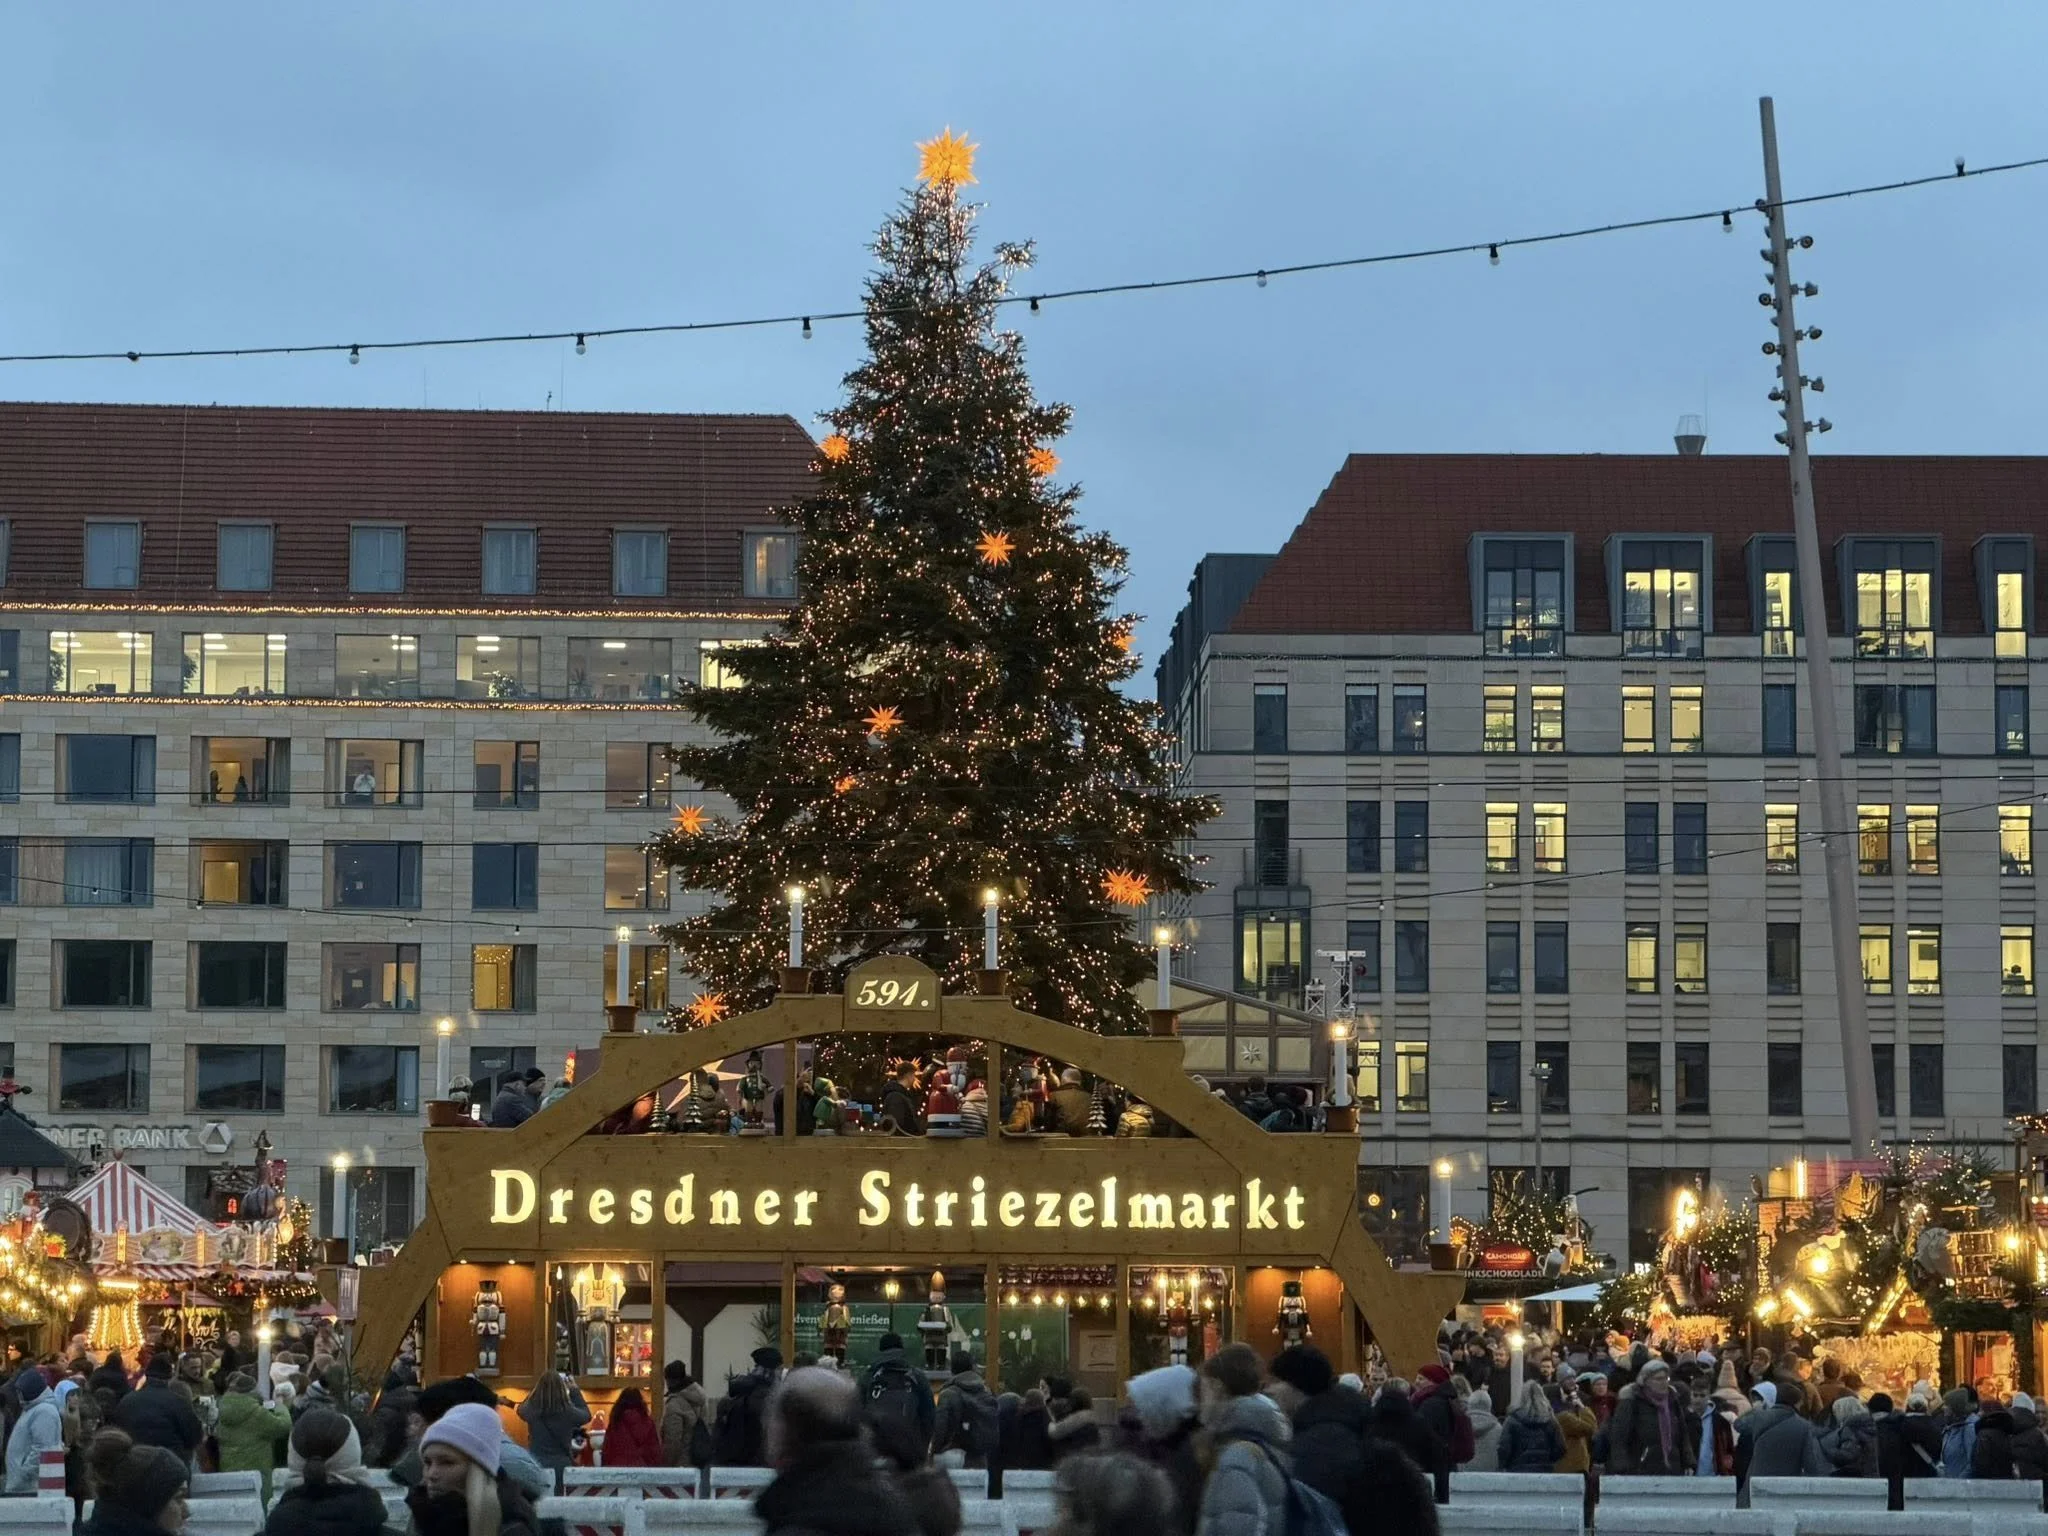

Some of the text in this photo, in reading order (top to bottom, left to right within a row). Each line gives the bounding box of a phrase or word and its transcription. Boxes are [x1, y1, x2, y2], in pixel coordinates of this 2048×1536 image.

[857, 980, 929, 1007] 591.
[113, 1127, 190, 1149] BANK
[490, 1169, 1305, 1230] Dresdner Striezelmarkt
